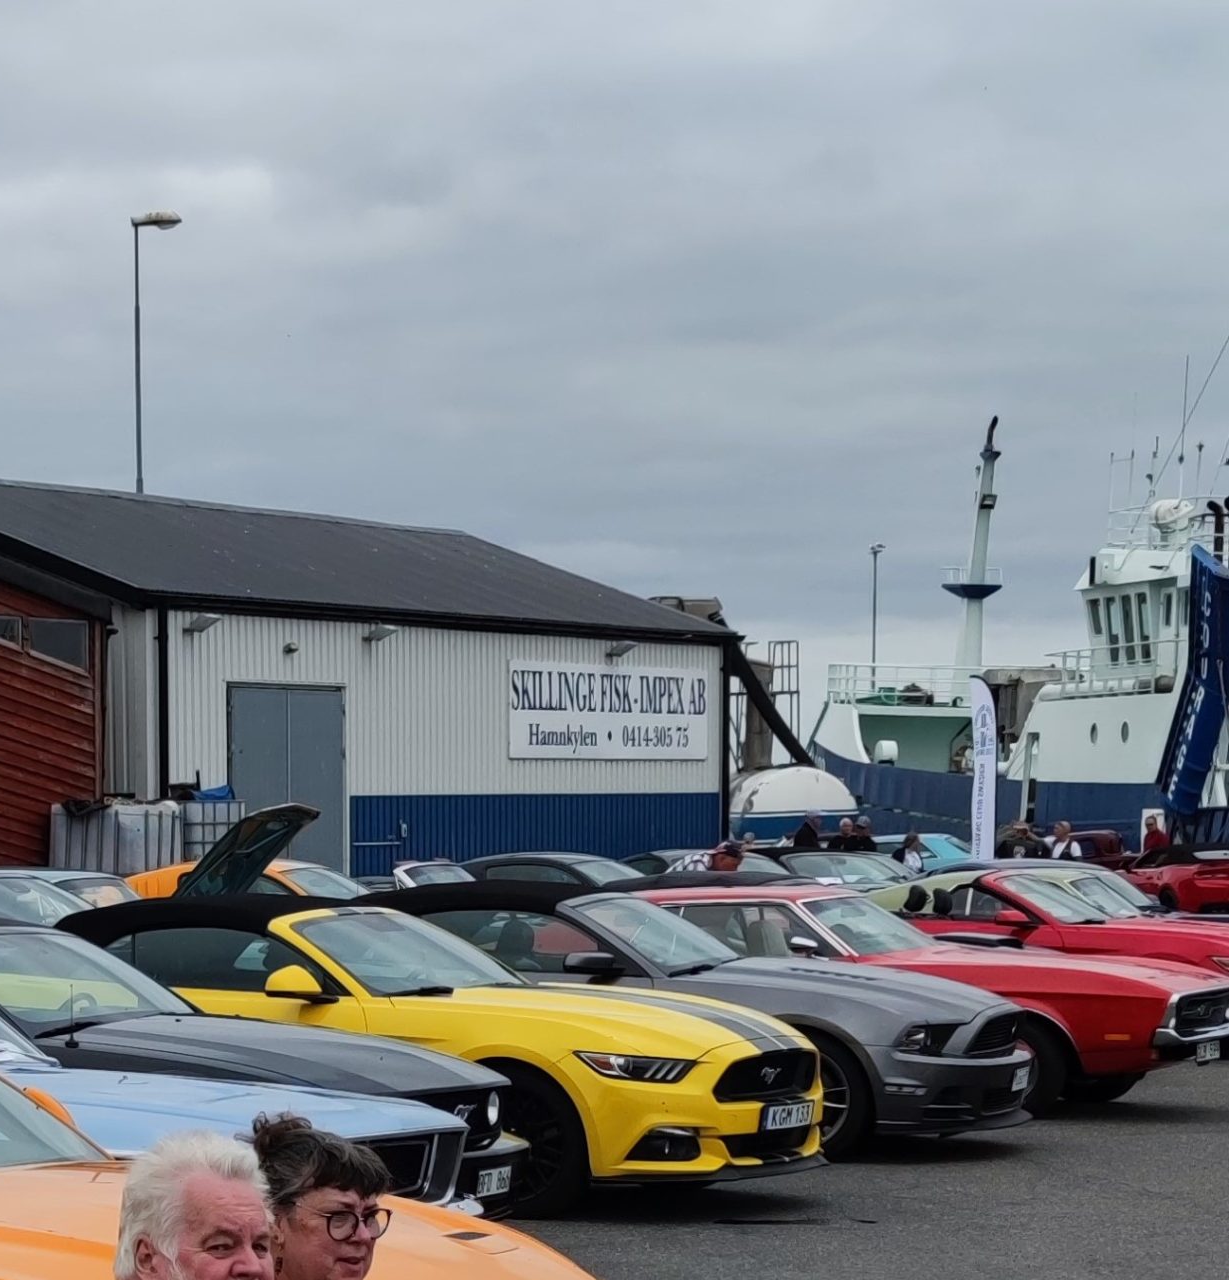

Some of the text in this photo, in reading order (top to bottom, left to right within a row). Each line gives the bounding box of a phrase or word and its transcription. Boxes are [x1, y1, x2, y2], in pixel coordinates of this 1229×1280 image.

[511, 669, 597, 713] SKILLINGE
[688, 677, 707, 716] AB
[528, 722, 598, 754] Hamnkylen
[675, 723, 690, 749] 75
